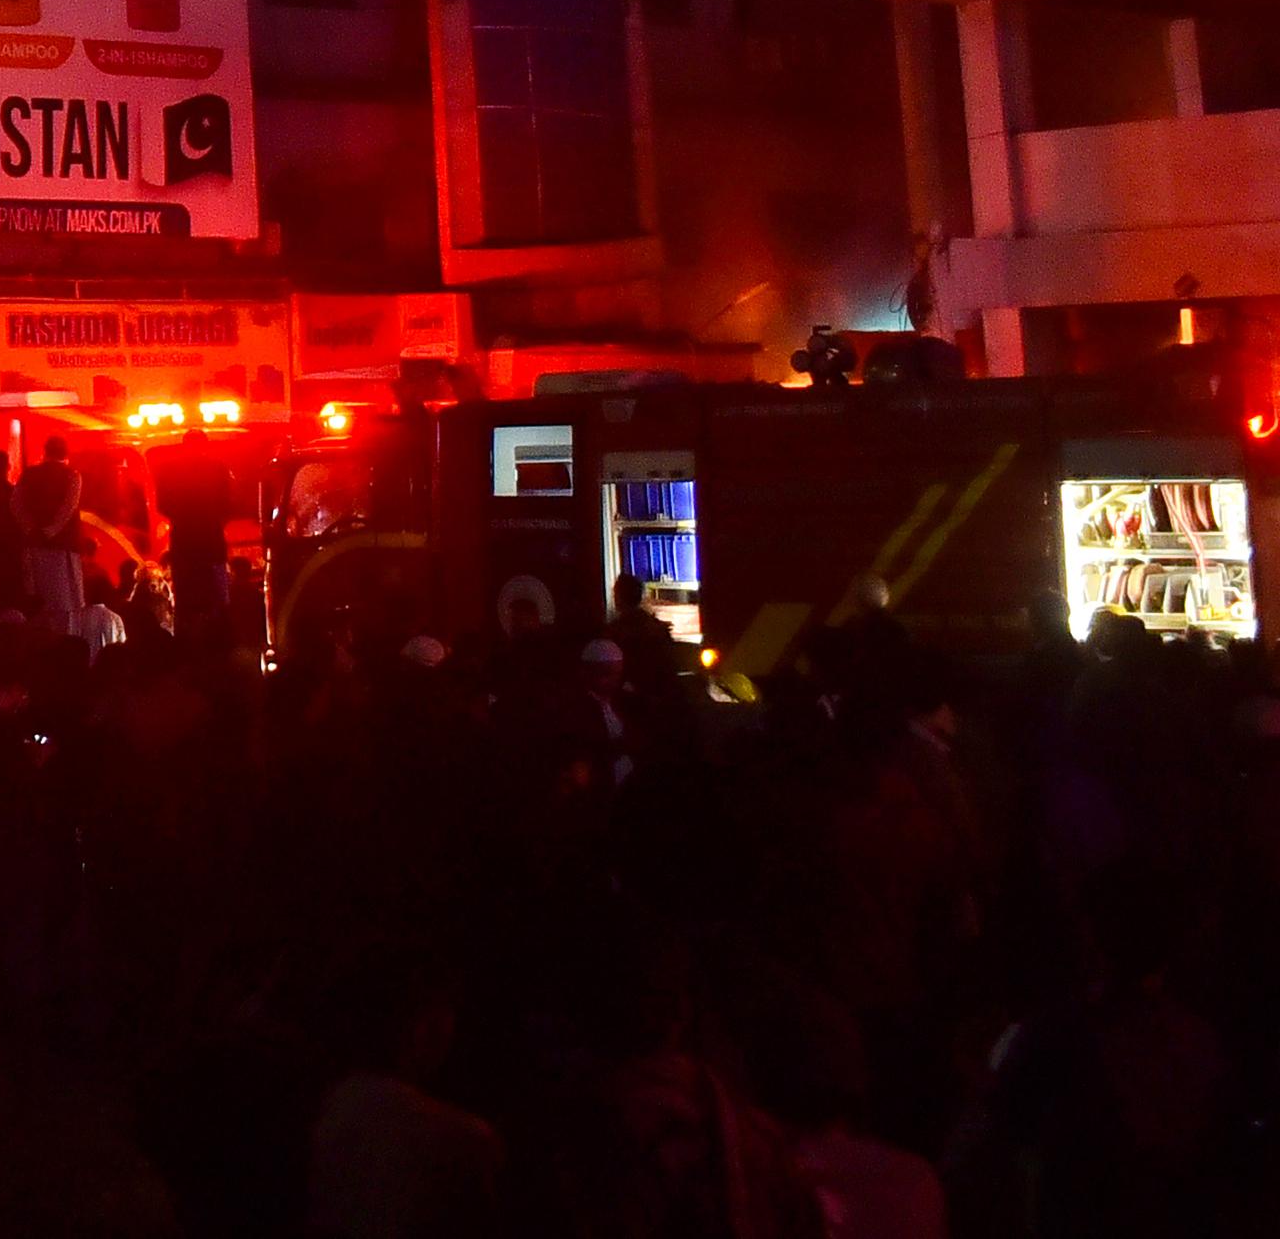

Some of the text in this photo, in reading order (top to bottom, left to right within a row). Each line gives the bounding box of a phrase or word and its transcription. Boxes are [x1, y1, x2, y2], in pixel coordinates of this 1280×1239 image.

[9, 207, 40, 232] NOW
[44, 208, 63, 232] AT
[66, 208, 162, 234] MAKS.COM.PK
[5, 312, 121, 347] FASHION
